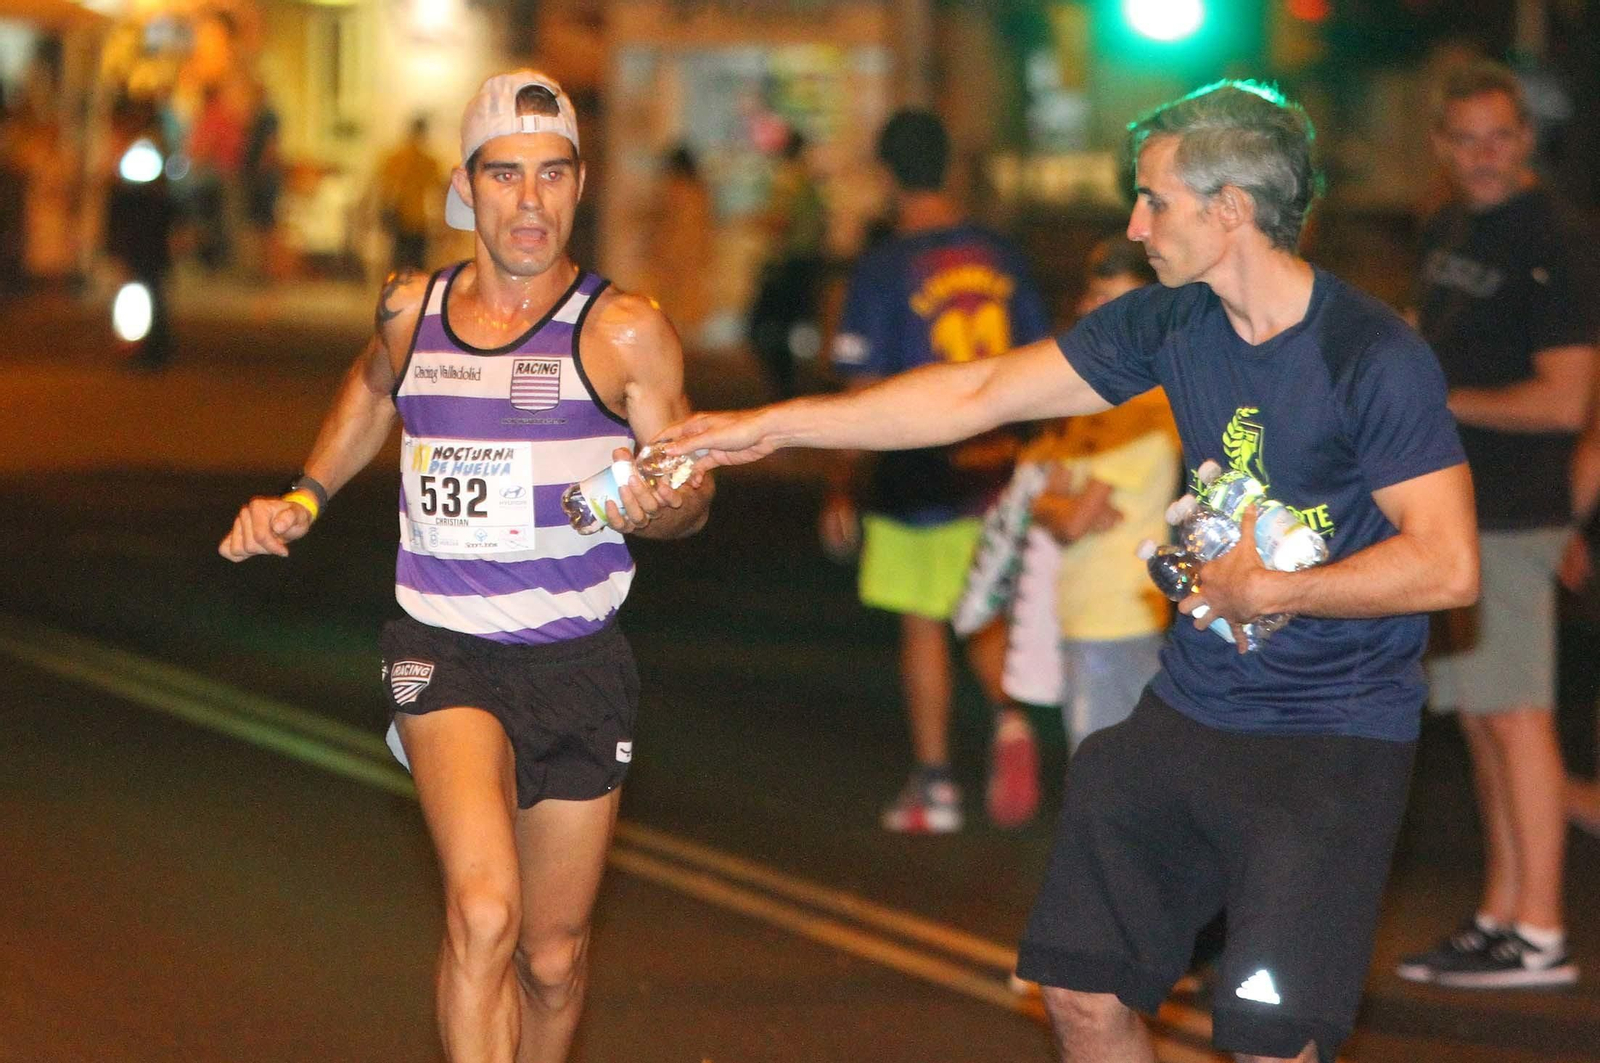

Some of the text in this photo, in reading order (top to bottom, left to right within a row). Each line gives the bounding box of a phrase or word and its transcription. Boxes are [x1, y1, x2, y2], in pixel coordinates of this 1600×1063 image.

[439, 365, 482, 381] Valladolid
[515, 362, 559, 376] RACING
[432, 446, 515, 461] NOCTURNA
[428, 460, 512, 477] DE HUELVA
[420, 475, 489, 518] 532
[435, 518, 469, 527] CHRISTIAN
[393, 664, 431, 677] RACING
